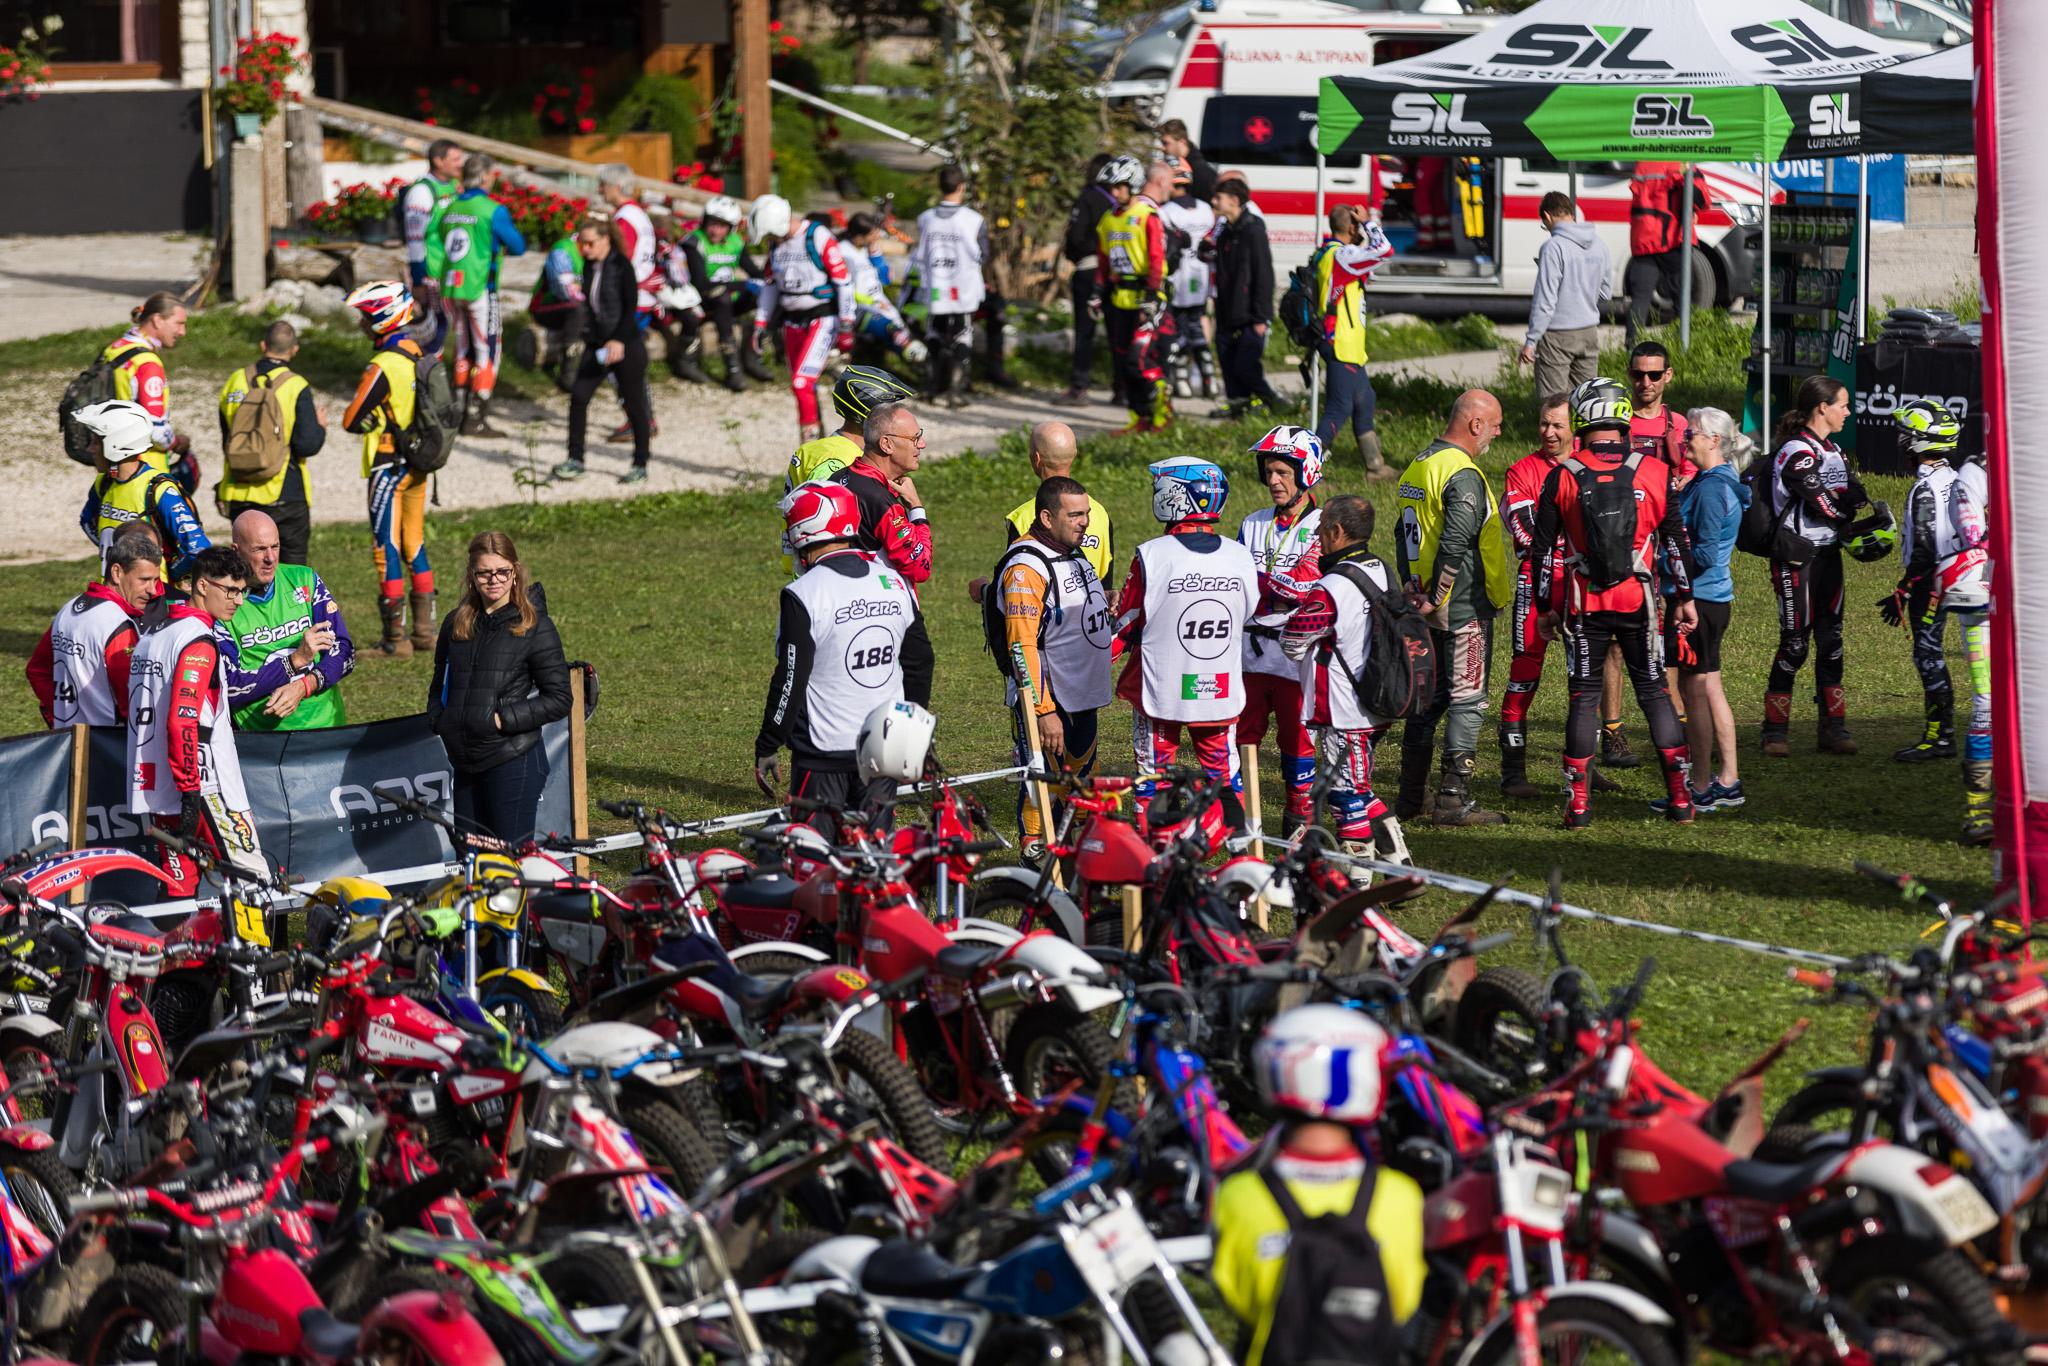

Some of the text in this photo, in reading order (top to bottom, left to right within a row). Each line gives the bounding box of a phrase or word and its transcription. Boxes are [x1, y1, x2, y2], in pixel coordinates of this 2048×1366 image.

[1487, 23, 1674, 69] SIL
[1731, 18, 1879, 66] SIL
[1472, 66, 1670, 80] LUBRICANTS
[1785, 57, 1894, 77] LUBRICANTS
[1390, 92, 1491, 134] SIL
[1634, 96, 1711, 126] SIL
[1809, 92, 1861, 136] SIL
[1388, 134, 1493, 147] LUBRICANTS
[1633, 128, 1712, 136] LUBRICANTS
[1807, 136, 1861, 149] LUBRICANT
[1168, 574, 1241, 594] SÖRRA
[1276, 573, 1292, 585] CLUB
[1783, 579, 1794, 598] CLUB
[836, 599, 902, 624] SÖRRA
[1020, 600, 1039, 617] Service
[1515, 574, 1528, 652] Luxembourg
[241, 615, 312, 648] SÖRRA
[1182, 619, 1231, 641] 165
[851, 645, 893, 670] 188
[1581, 656, 1590, 678] TRIAL
[374, 1025, 417, 1050] FANTIC
